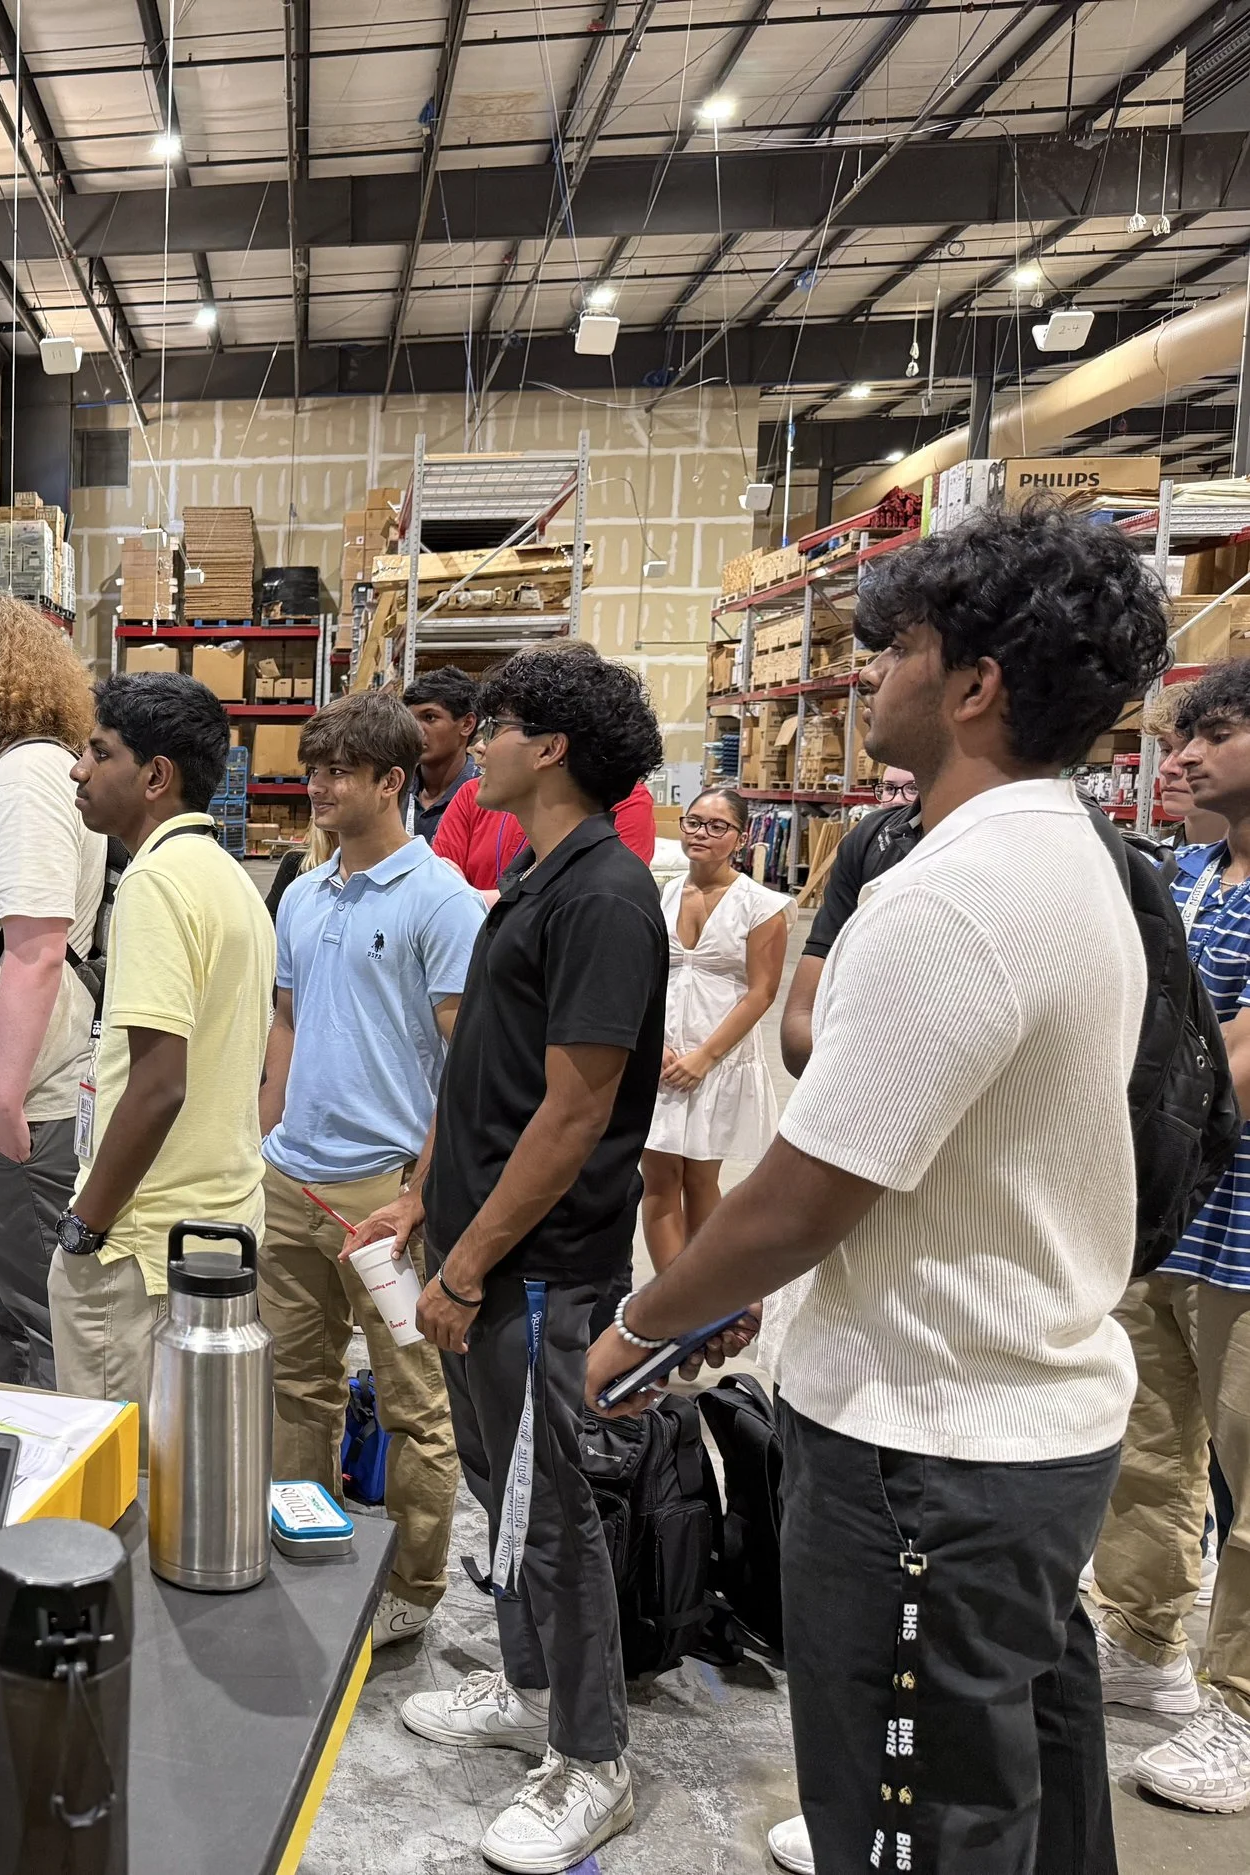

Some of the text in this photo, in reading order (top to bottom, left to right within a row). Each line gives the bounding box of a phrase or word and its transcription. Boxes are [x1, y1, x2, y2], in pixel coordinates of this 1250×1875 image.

[1019, 472, 1101, 487] PHILIPS
[275, 1487, 320, 1524] ALTOIDS
[902, 1603, 918, 1641] BHS
[898, 1717, 914, 1756] BHS
[869, 1829, 885, 1869] BHS
[896, 1831, 912, 1871] BHS
